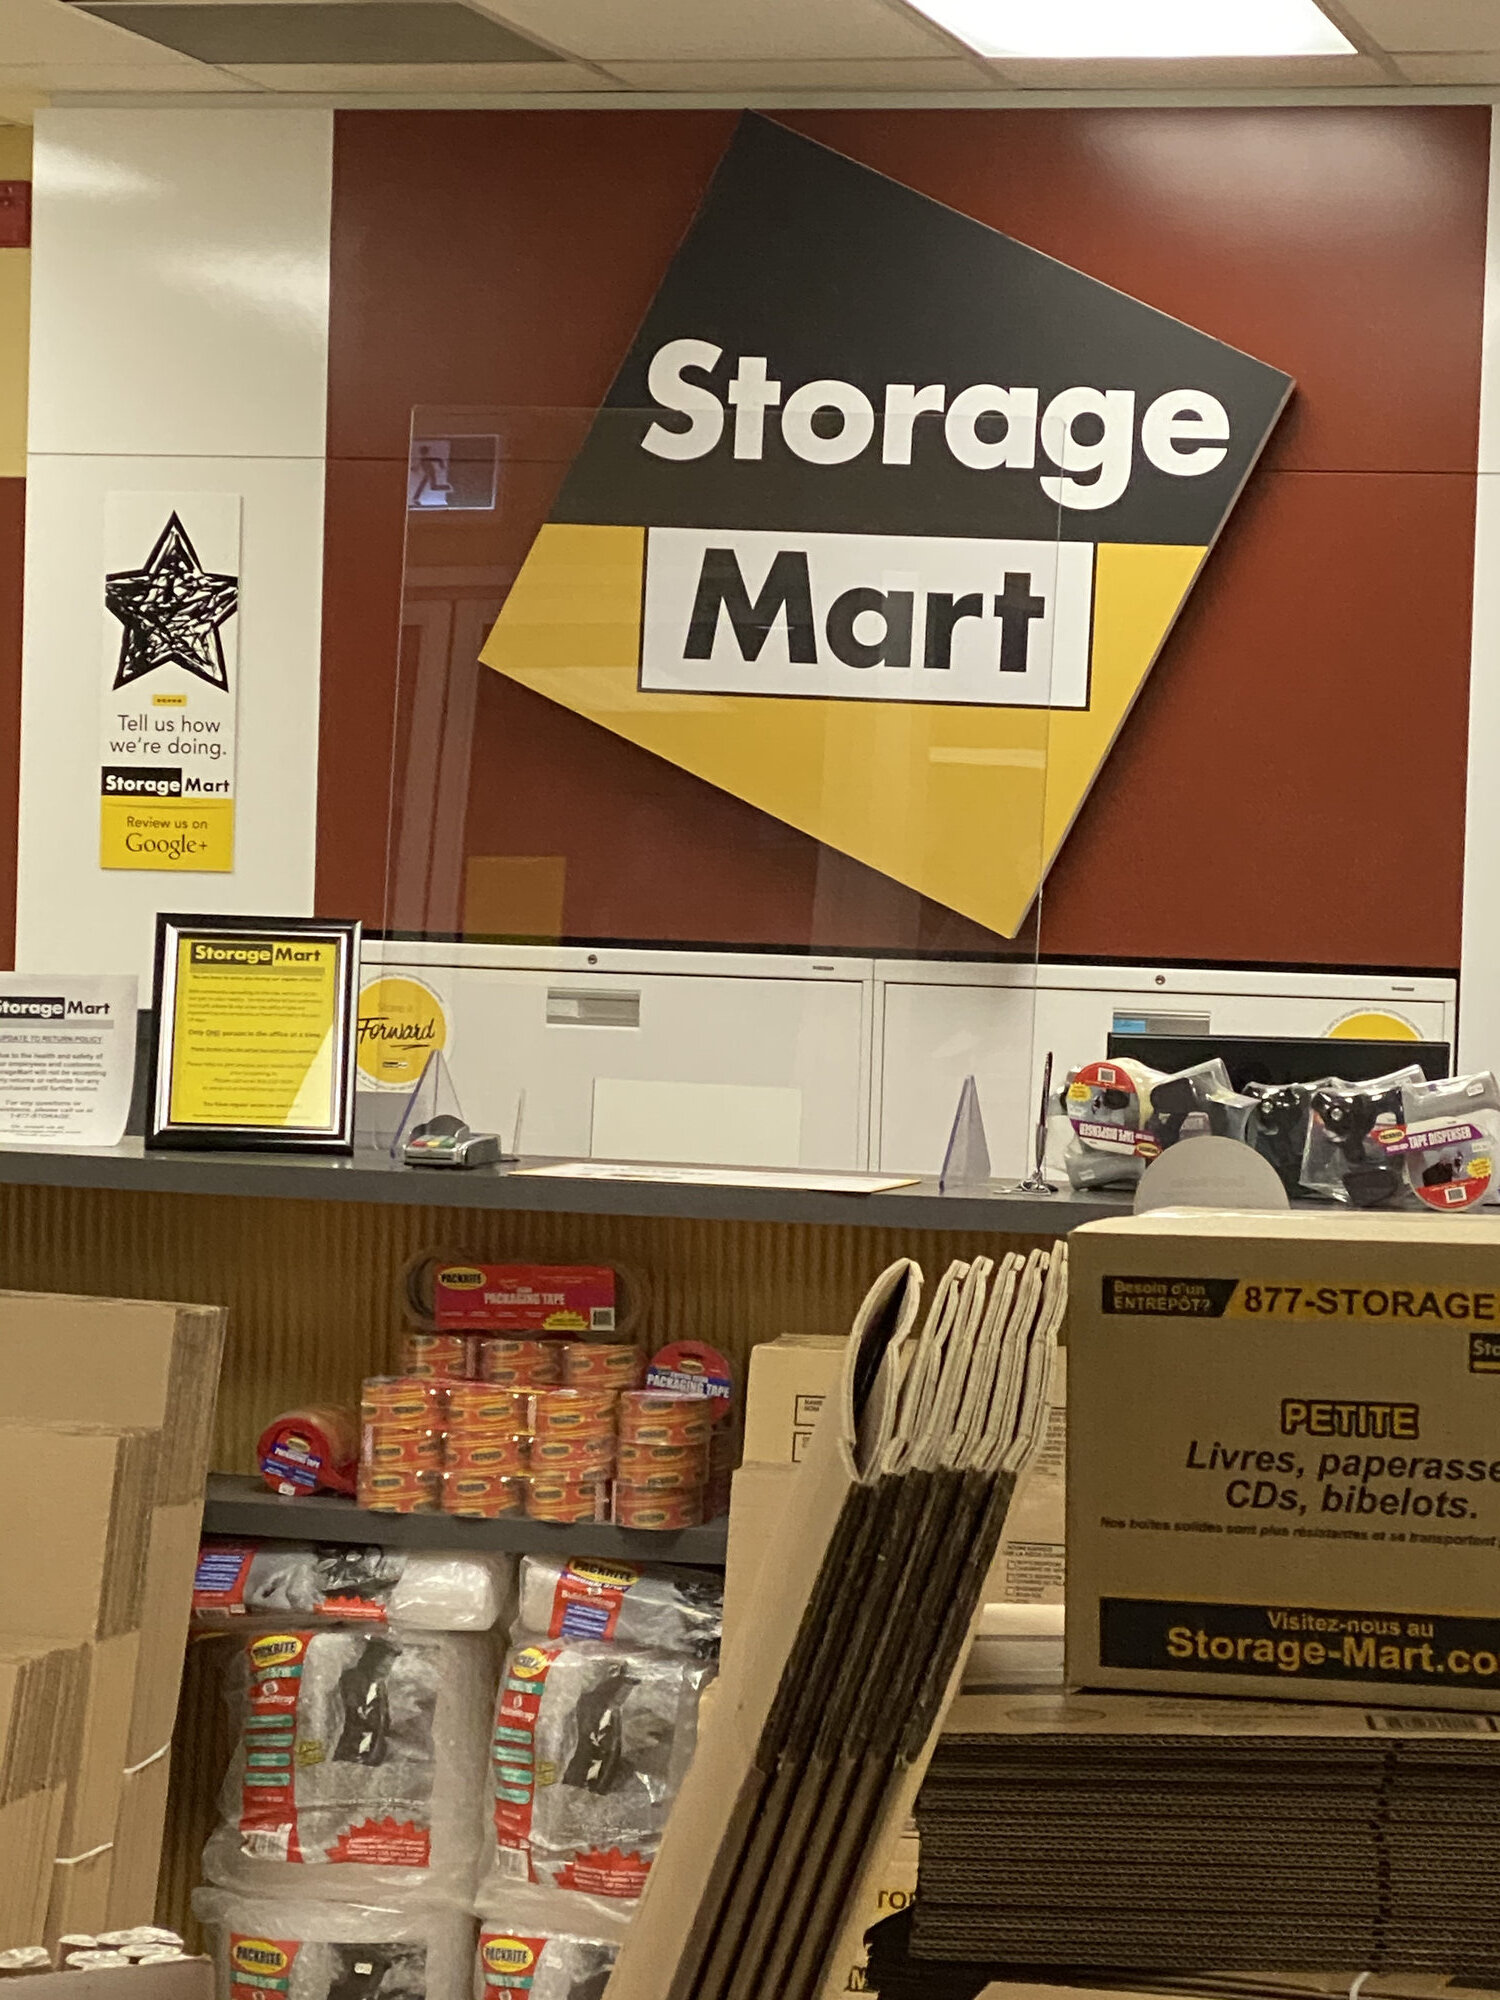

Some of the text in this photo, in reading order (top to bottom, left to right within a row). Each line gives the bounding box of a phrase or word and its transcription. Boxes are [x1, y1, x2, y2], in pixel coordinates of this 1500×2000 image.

[640, 338, 1230, 511] Storage
[682, 548, 1046, 673] Mart
[117, 714, 220, 732] Tell us how
[110, 737, 227, 760] we’re doing.
[105, 775, 231, 796] Storage Mart
[127, 816, 208, 829] Review us on
[125, 833, 208, 860] Google+
[195, 945, 321, 964] Storage Mart
[0, 1000, 110, 1018] torage Mart
[358, 1017, 435, 1044] Forward
[1408, 1134, 1429, 1149] TAPE
[1428, 1126, 1472, 1146] DISPENSER
[1113, 1280, 1168, 1295] Besoin
[1244, 1286, 1495, 1321] 877-STORAGE
[647, 1373, 704, 1394] PACKAGING
[707, 1383, 730, 1399] TAPE
[1281, 1398, 1419, 1440] PETITE
[1185, 1440, 1304, 1478] Livres,
[1226, 1479, 1478, 1519] CDs, bibelots.
[573, 1560, 630, 1582] PACKRITE
[1266, 1611, 1434, 1638] Visitez-nous au
[1167, 1626, 1500, 1676] Storage-Mart.co
[236, 1945, 281, 1966] PACKRITE
[485, 1947, 527, 1964] PACKRITE
